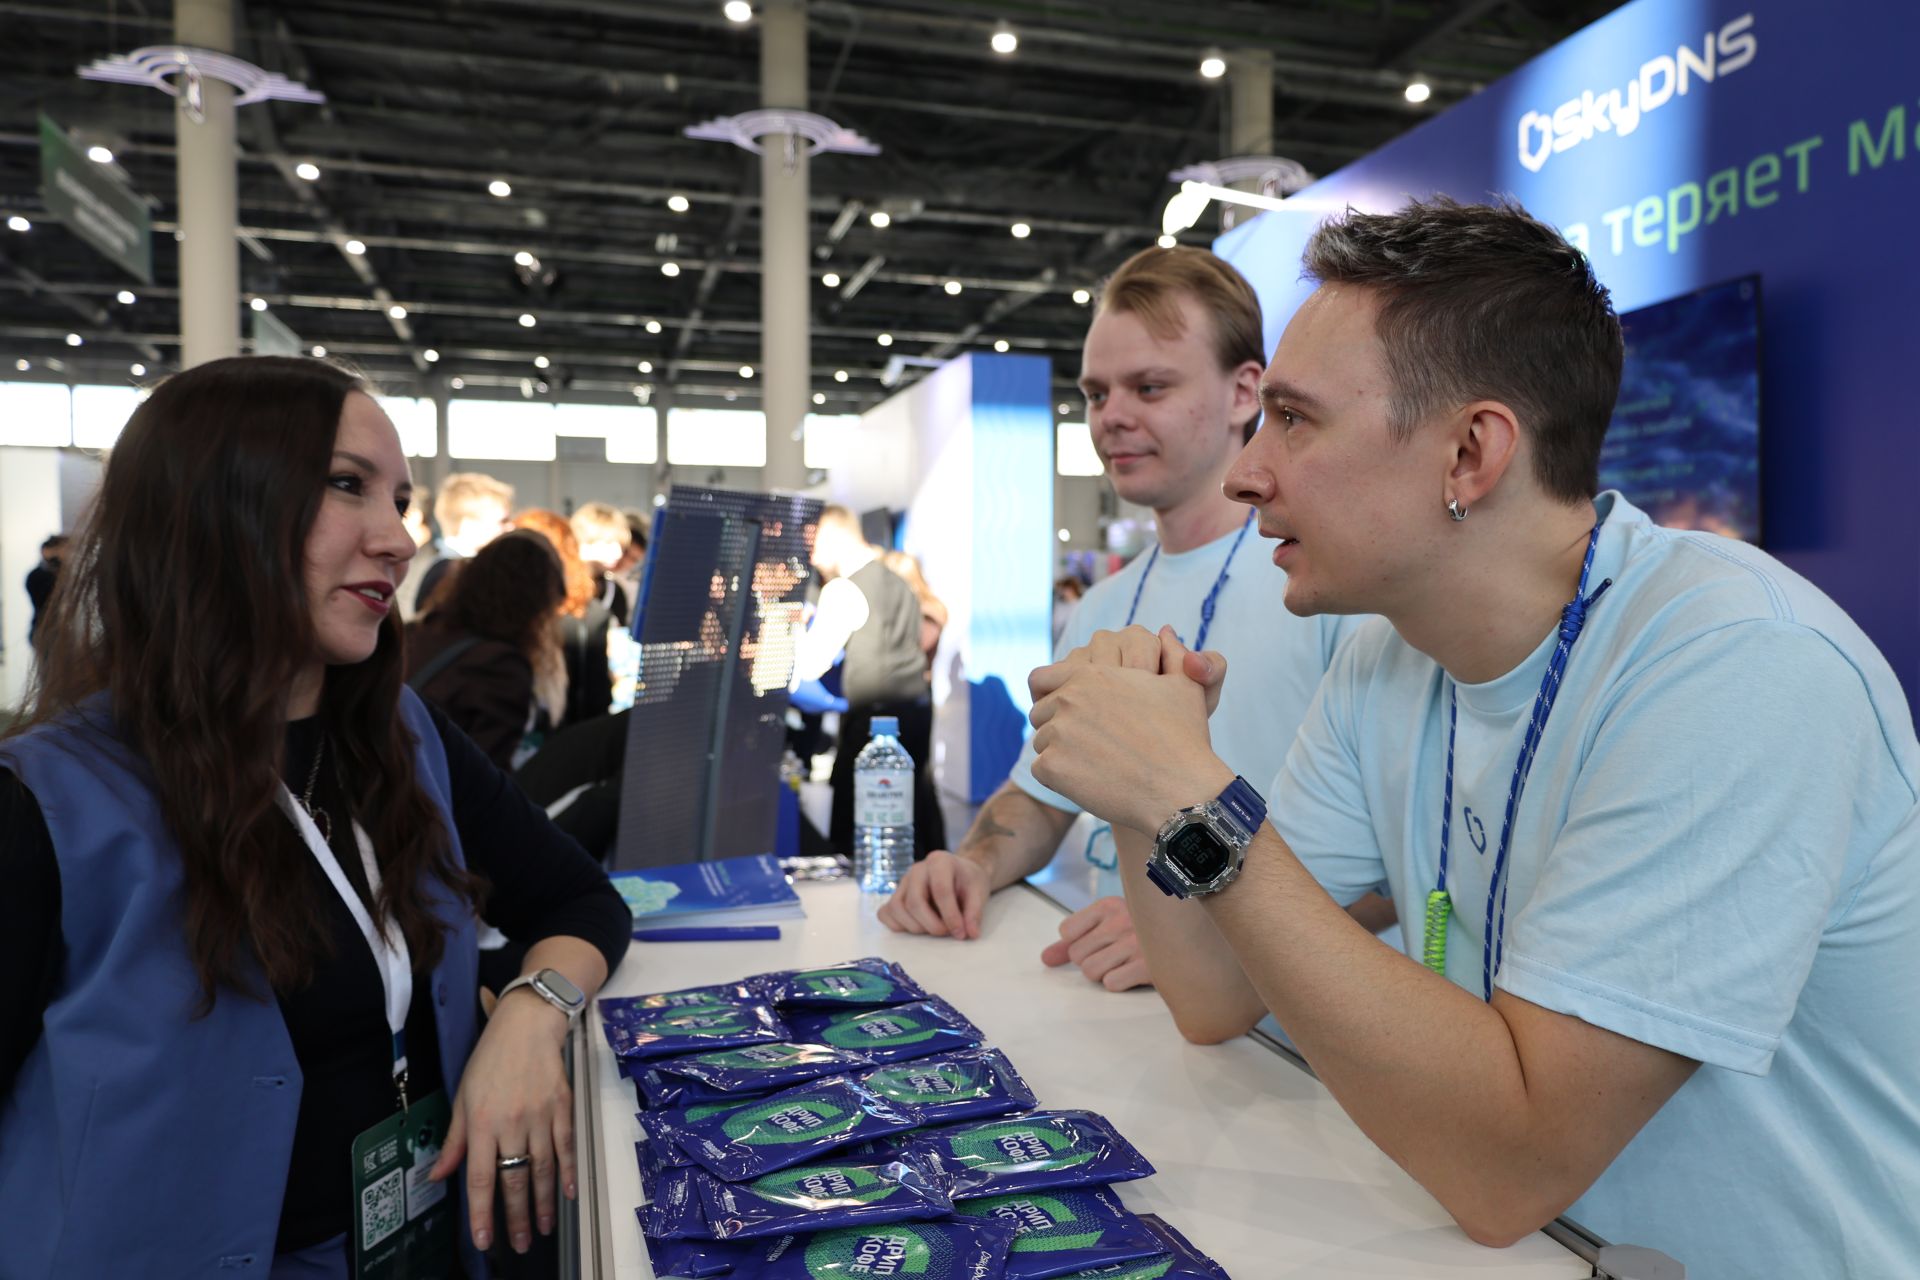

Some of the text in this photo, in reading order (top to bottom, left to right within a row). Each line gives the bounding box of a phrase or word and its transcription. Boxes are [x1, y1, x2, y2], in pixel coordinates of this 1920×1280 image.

[1602, 136, 1823, 255] теряет
[1165, 860, 1190, 886] G-SHOCK
[768, 1112, 805, 1134] КОФЕ
[783, 1105, 823, 1128] ДРИП
[999, 1135, 1031, 1164] КОФЕ
[1017, 1131, 1050, 1159] ДРИП
[802, 1174, 830, 1198] КОФЕ
[820, 1170, 852, 1195] ДРИП
[1009, 1200, 1053, 1230] ДРИП
[849, 1233, 884, 1273] КОФЕ
[872, 1234, 909, 1275] ДРИП
